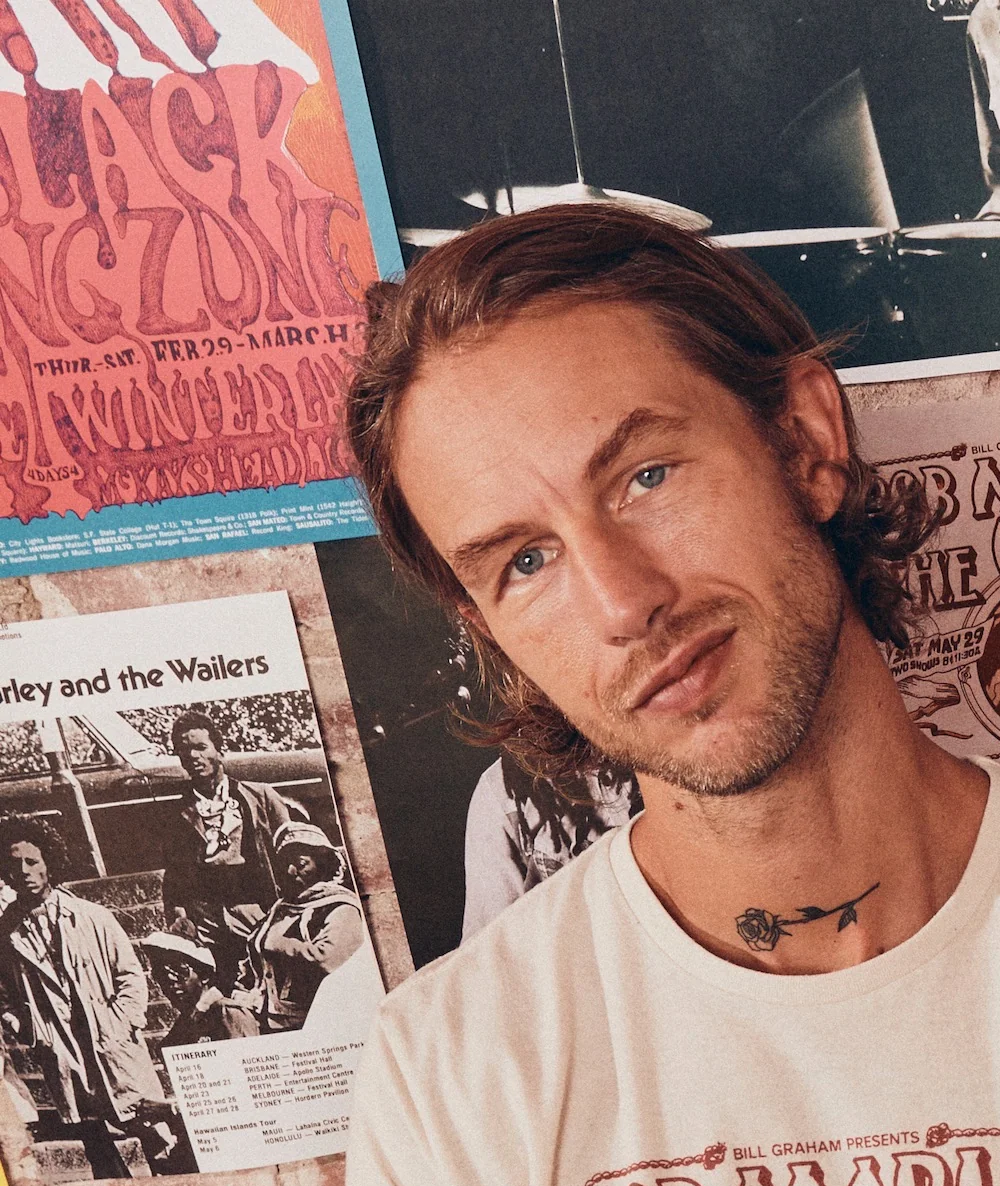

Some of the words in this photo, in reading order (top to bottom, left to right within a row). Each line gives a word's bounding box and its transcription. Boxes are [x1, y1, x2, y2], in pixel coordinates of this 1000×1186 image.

[971, 444, 993, 454] BILL
[928, 634, 961, 657] MAY
[964, 626, 985, 648] 29
[910, 657, 940, 672] SHOWS
[60, 668, 111, 698] and
[117, 665, 164, 692] the
[166, 654, 270, 684] Wailers
[171, 1048, 216, 1061] ITINERARY
[241, 1054, 279, 1065] AUCKLAND
[291, 1049, 319, 1058] Western
[321, 1044, 347, 1054] Springs
[244, 1063, 279, 1073] BRISBANE
[292, 1058, 317, 1067] Festival
[247, 1072, 280, 1082] ADELAIDE
[315, 1062, 342, 1071] Stadium
[249, 1082, 271, 1090] PERTH
[284, 1073, 330, 1085] Entertainment
[332, 1069, 353, 1077] Centre
[252, 1088, 294, 1099] MELBOURNE
[307, 1082, 332, 1091] Festival
[254, 1098, 282, 1108] SYDNEY
[194, 1125, 228, 1135] Hawaiian
[230, 1121, 257, 1130] Islands
[197, 1137, 210, 1145] May
[295, 1121, 321, 1130] Lahaina
[322, 1117, 338, 1125] Civic
[264, 1133, 302, 1144] HONOLULU
[314, 1126, 339, 1135] Waikiki
[733, 1145, 767, 1161] BILL
[772, 1139, 842, 1157] GRAHAM
[846, 1131, 920, 1150] PRESENTS
